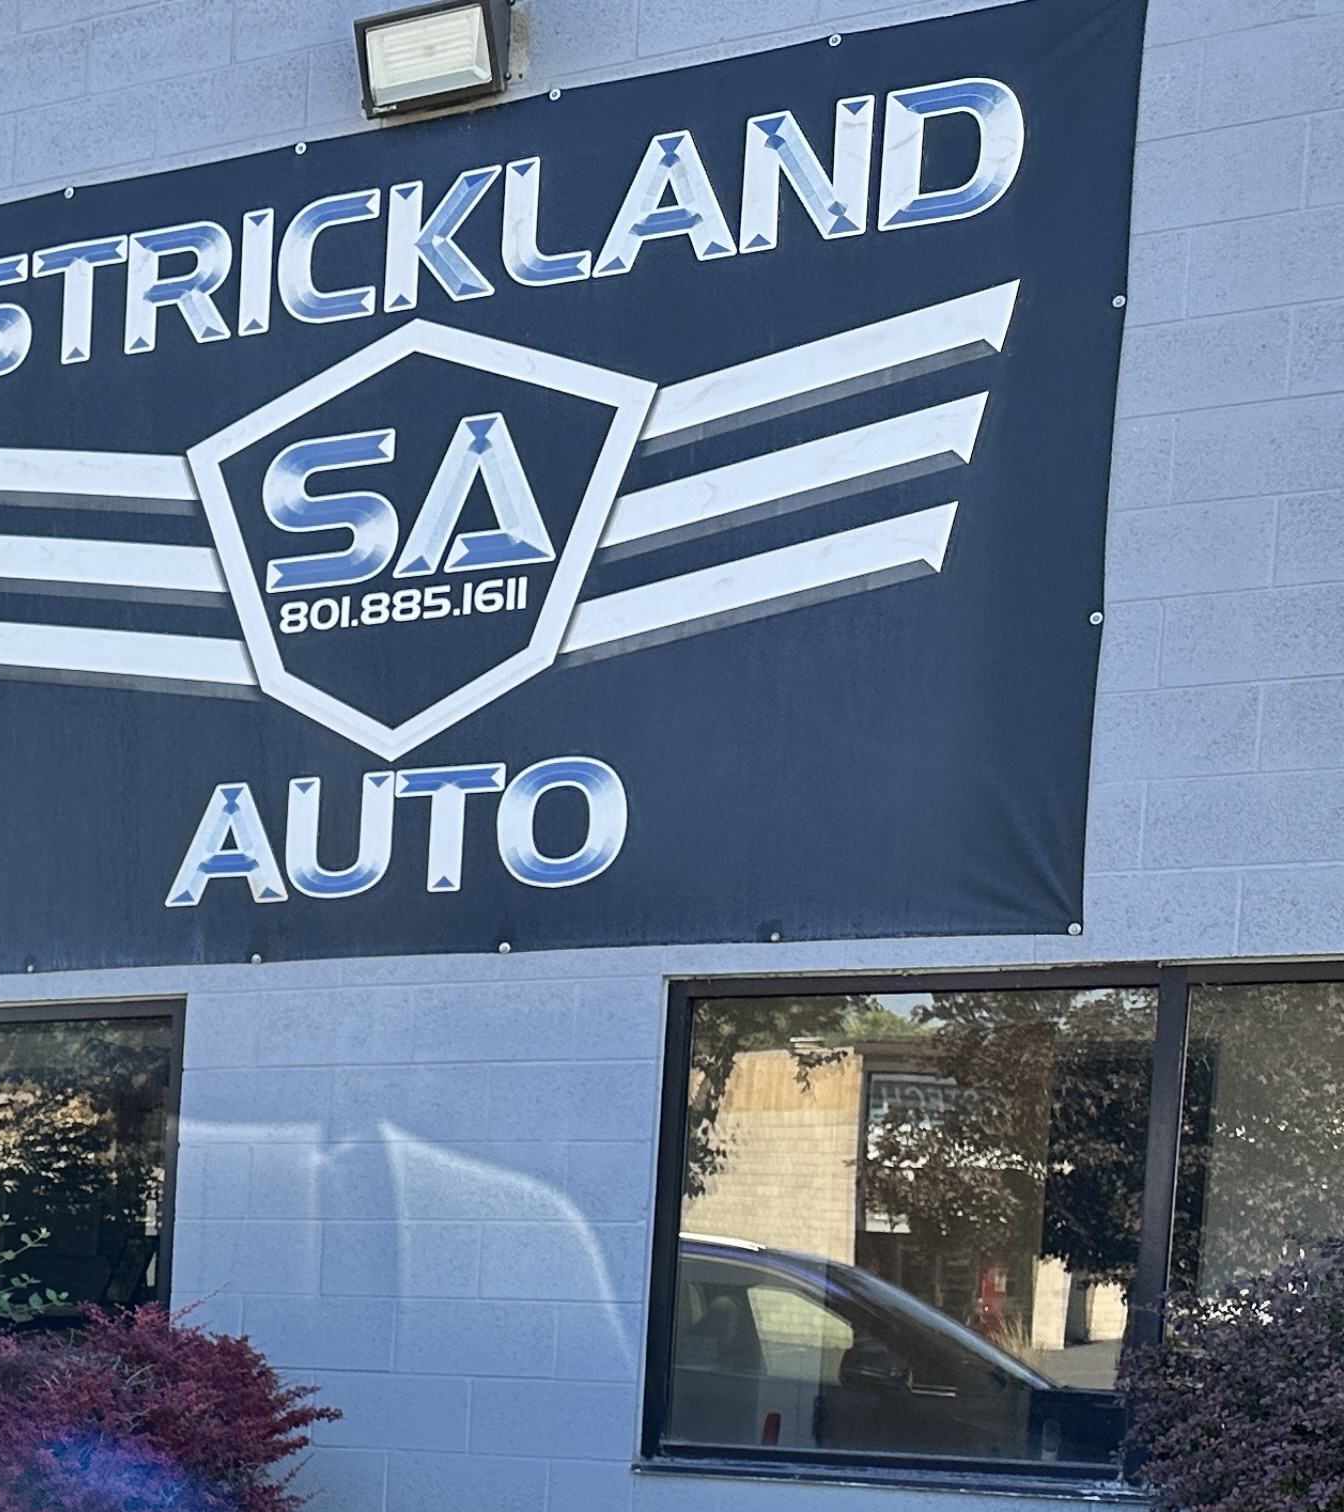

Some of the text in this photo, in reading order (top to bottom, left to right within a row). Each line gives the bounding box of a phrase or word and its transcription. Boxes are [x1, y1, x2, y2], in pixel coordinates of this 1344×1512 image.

[263, 411, 556, 593] SA
[278, 575, 529, 636] 801.885.1611
[164, 755, 630, 908] AUTO
